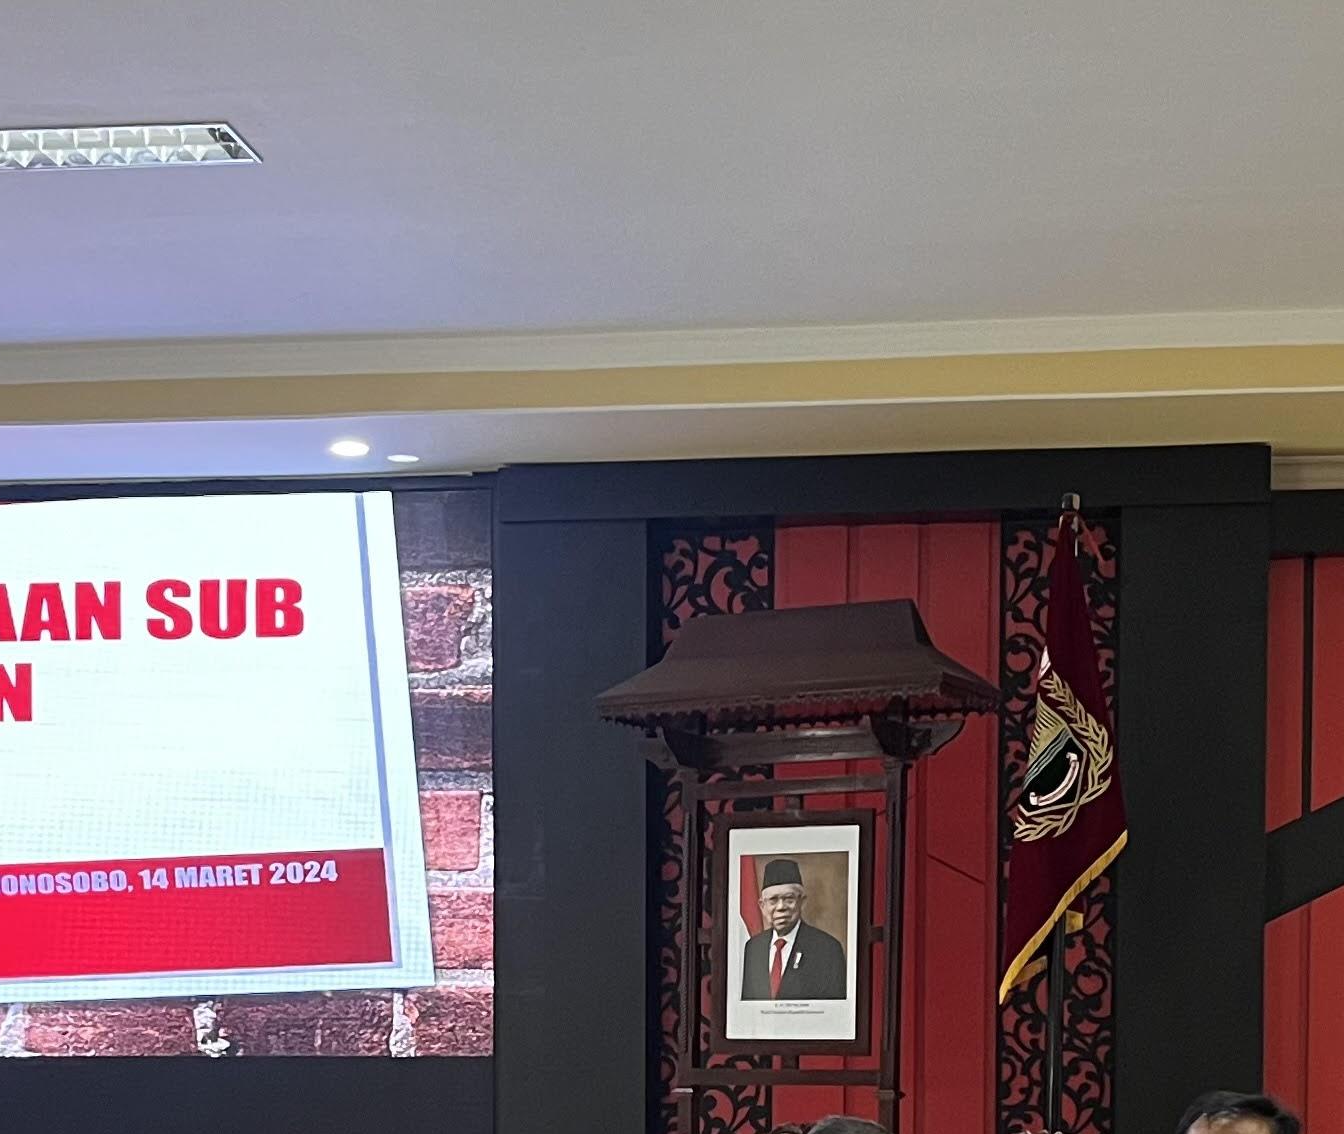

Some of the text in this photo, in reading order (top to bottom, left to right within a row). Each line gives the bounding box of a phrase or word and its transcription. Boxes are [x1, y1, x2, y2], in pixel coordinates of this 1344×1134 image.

[145, 578, 304, 640] SUB
[138, 867, 170, 890] 14
[174, 863, 264, 889] MARET
[268, 860, 339, 885] 2024
